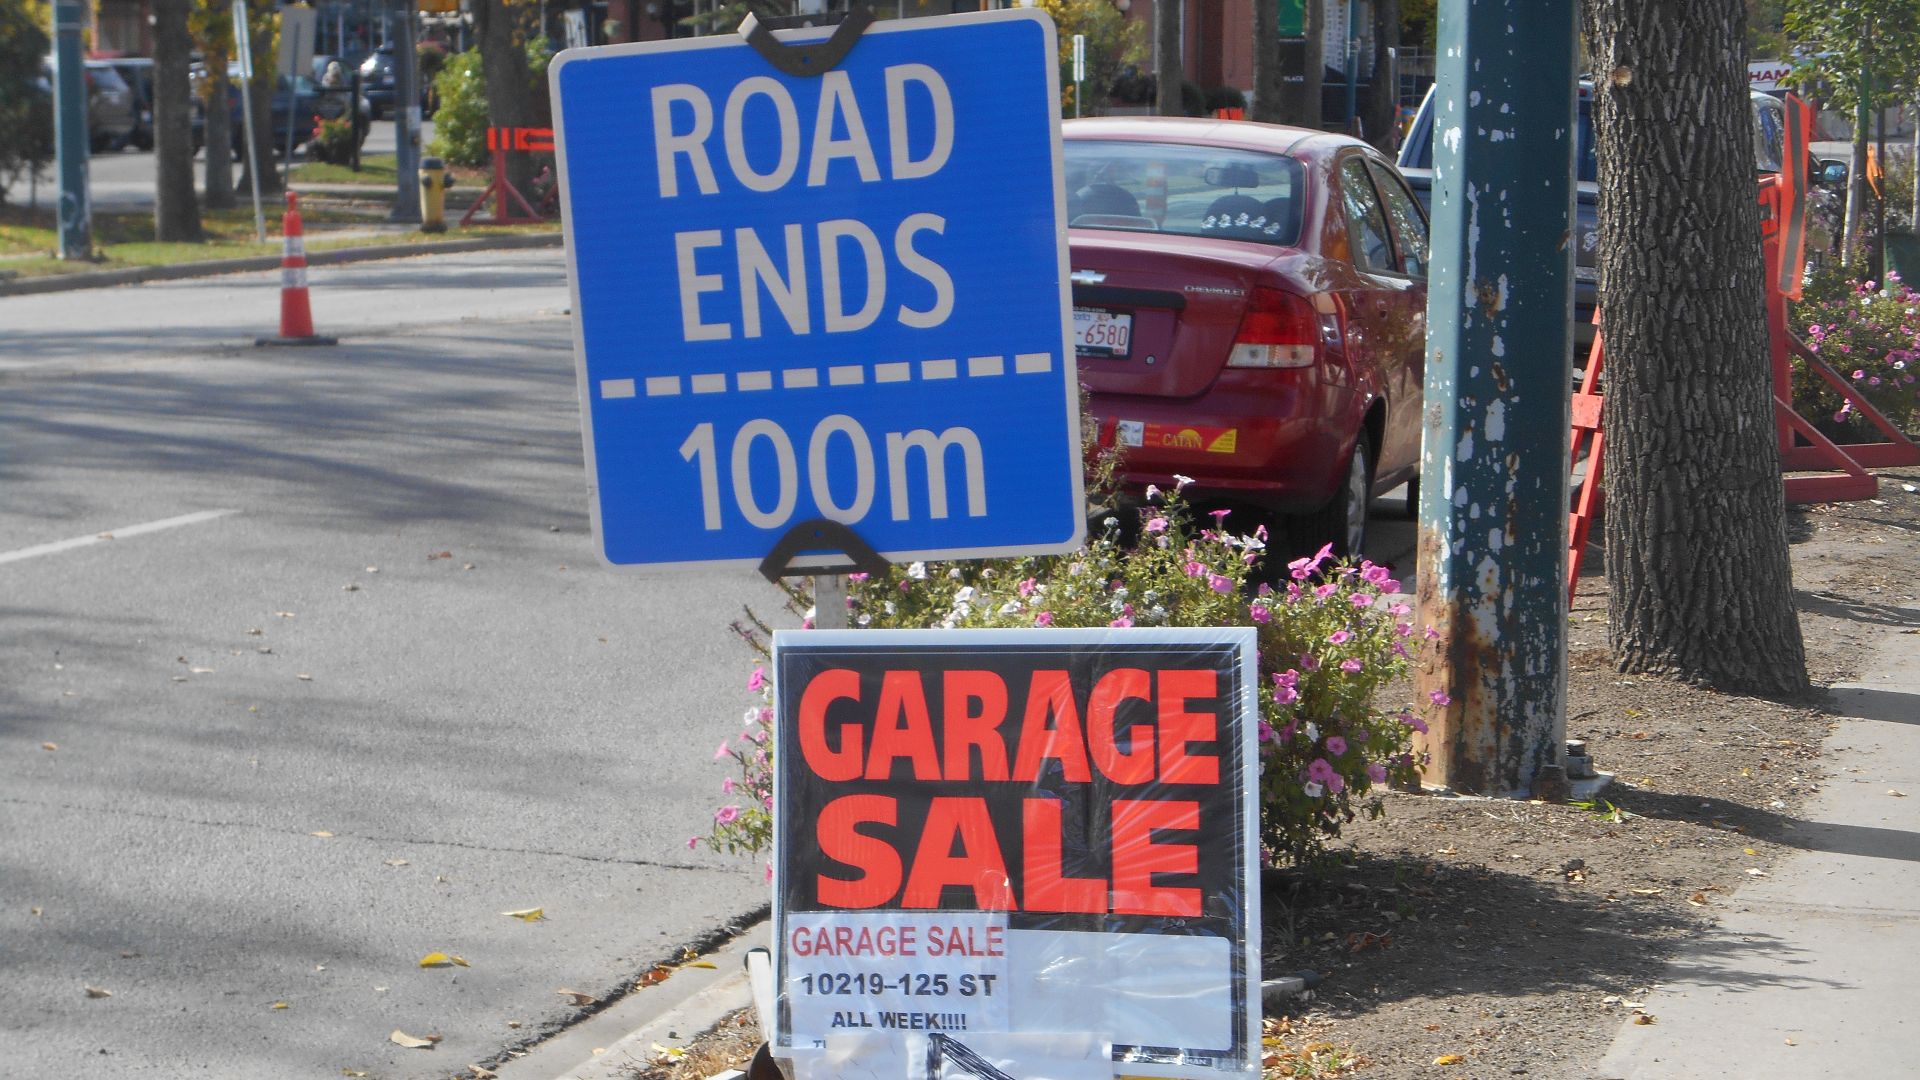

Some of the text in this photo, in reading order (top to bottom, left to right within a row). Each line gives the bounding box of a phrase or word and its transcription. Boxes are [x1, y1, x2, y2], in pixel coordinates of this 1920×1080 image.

[651, 62, 955, 198] ROAD
[675, 212, 956, 342] ENDS
[1183, 284, 1247, 297] CHEVROLET
[679, 414, 988, 531] 100m
[1162, 432, 1204, 449] CATAN
[798, 667, 1221, 786] GARAGE
[816, 793, 1204, 918] SALE
[792, 926, 1004, 957] GARAGE SALE
[831, 1011, 968, 1031] ALL WEEK!!!!
[958, 973, 997, 997] ST
